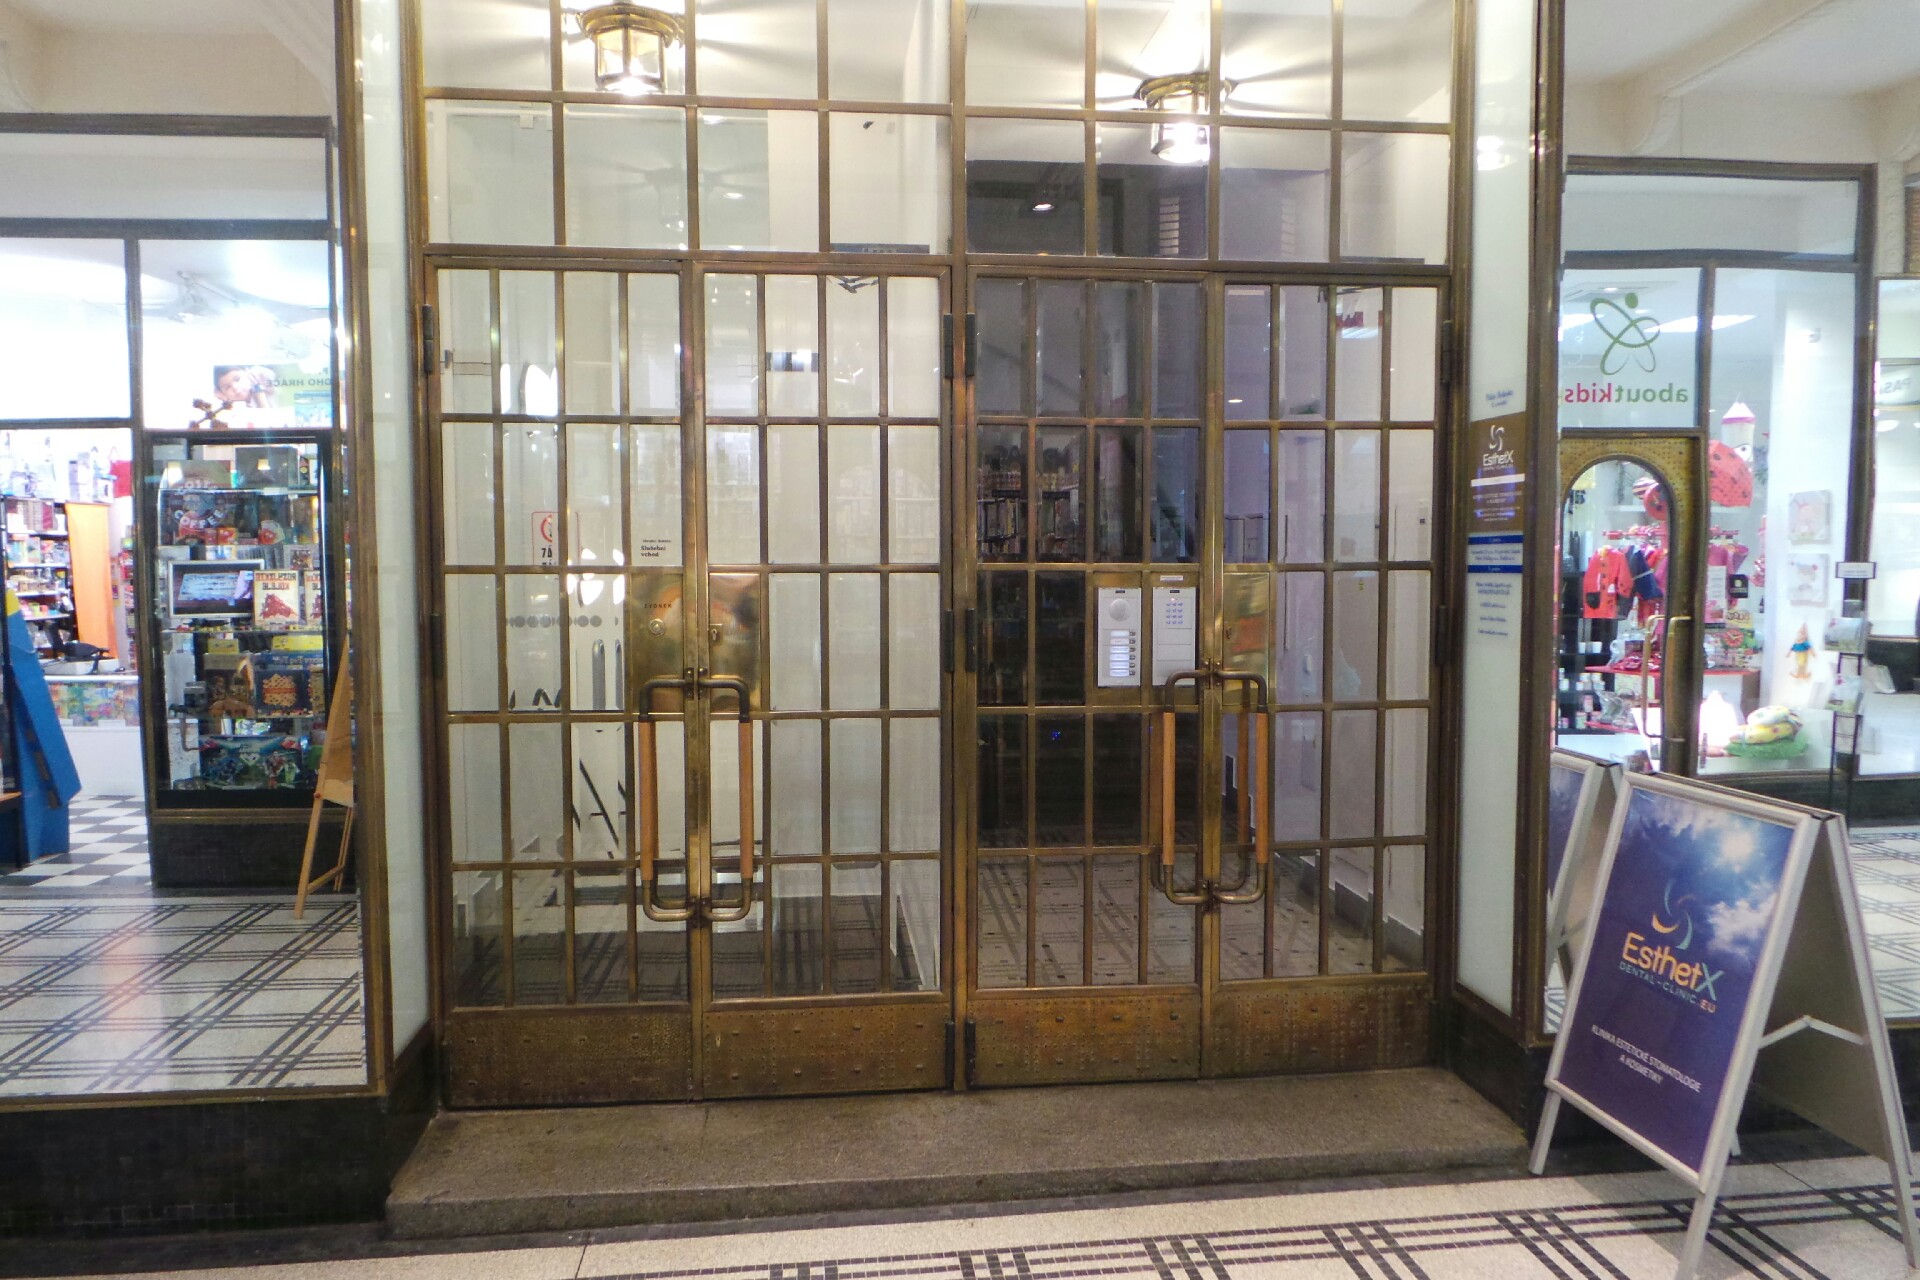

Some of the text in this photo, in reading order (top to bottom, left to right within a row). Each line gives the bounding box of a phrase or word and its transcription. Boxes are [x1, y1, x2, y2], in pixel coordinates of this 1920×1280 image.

[1482, 449, 1515, 467] EsthetX
[174, 509, 225, 529] COFFEE
[1622, 932, 1725, 1001] EsthetX
